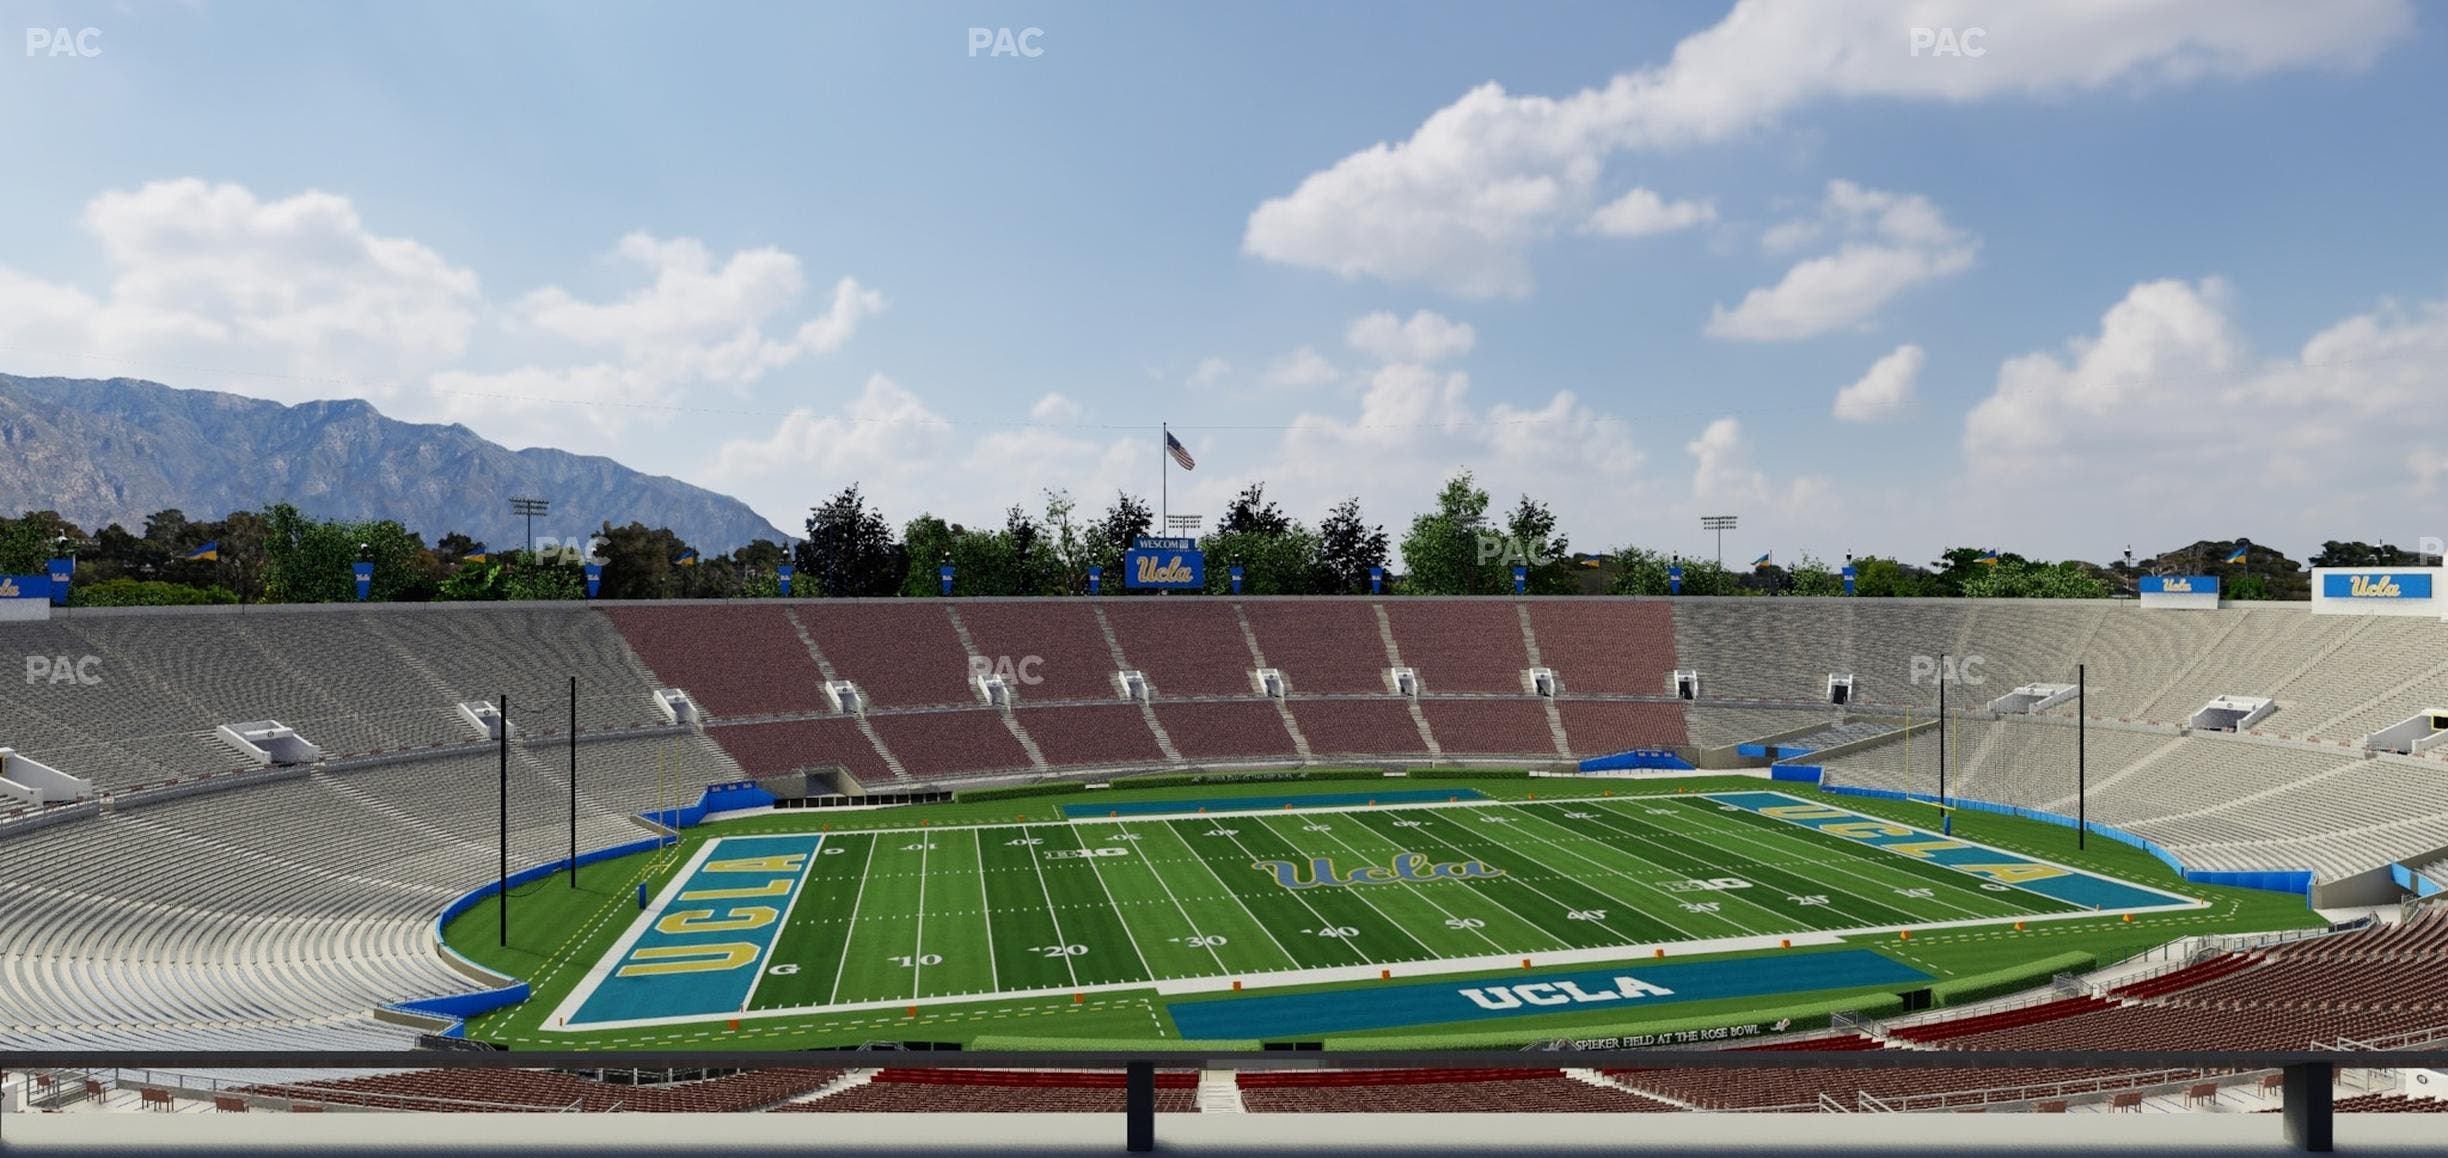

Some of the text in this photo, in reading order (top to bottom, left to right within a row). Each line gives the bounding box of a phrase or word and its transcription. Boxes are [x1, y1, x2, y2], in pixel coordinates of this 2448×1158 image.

[1140, 539, 1178, 549] WESCOM
[1758, 804, 2075, 884] UCLA
[616, 853, 807, 977] UCLA
[1444, 918, 1485, 929] 50
[1318, 926, 1360, 938] 40
[1184, 935, 1227, 947] 30
[1043, 944, 1089, 957] 20
[898, 954, 943, 967] 10
[769, 964, 801, 975] G
[1458, 976, 1675, 1010] UCLA
[1576, 1024, 1760, 1051] SPIEKER FIELD AT THE ROSE BOWL
